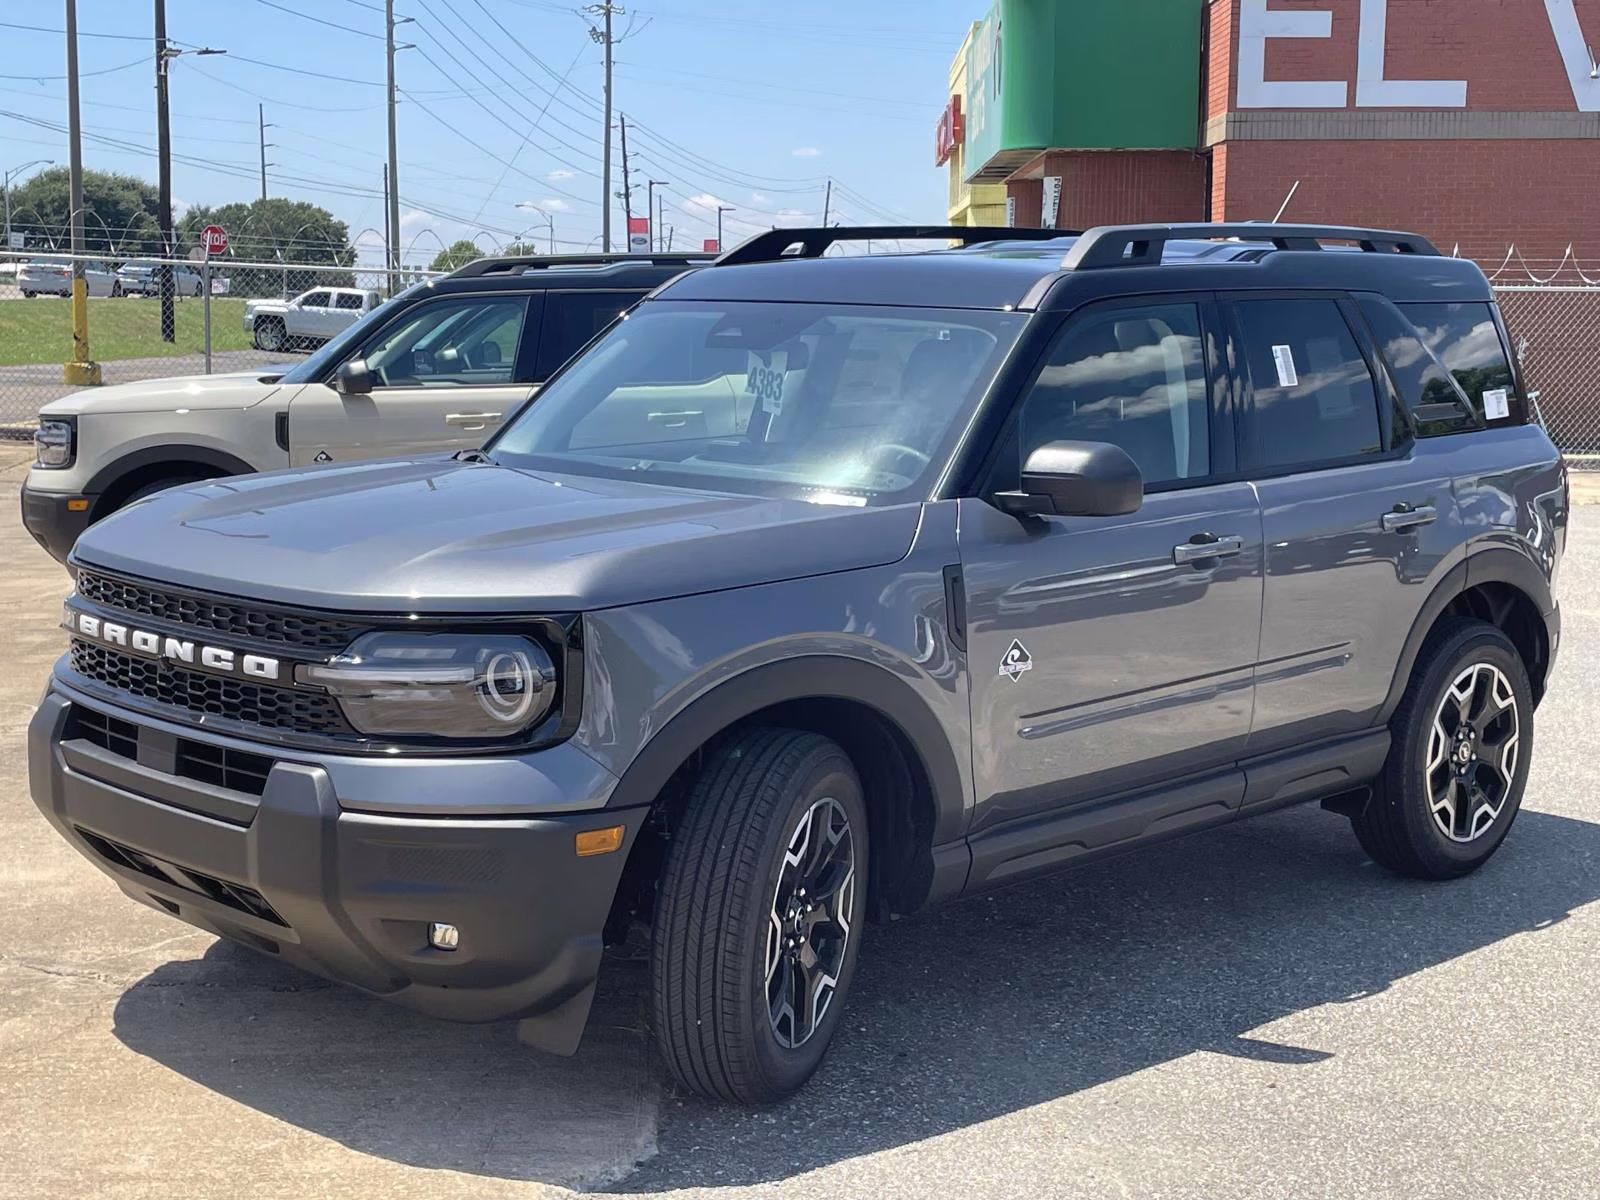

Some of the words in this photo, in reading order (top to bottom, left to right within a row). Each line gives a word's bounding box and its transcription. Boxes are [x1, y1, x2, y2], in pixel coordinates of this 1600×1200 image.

[1237, 0, 1467, 108] EL
[203, 232, 227, 246] STOP
[748, 366, 784, 401] 4383
[79, 614, 279, 680] BRONCO
